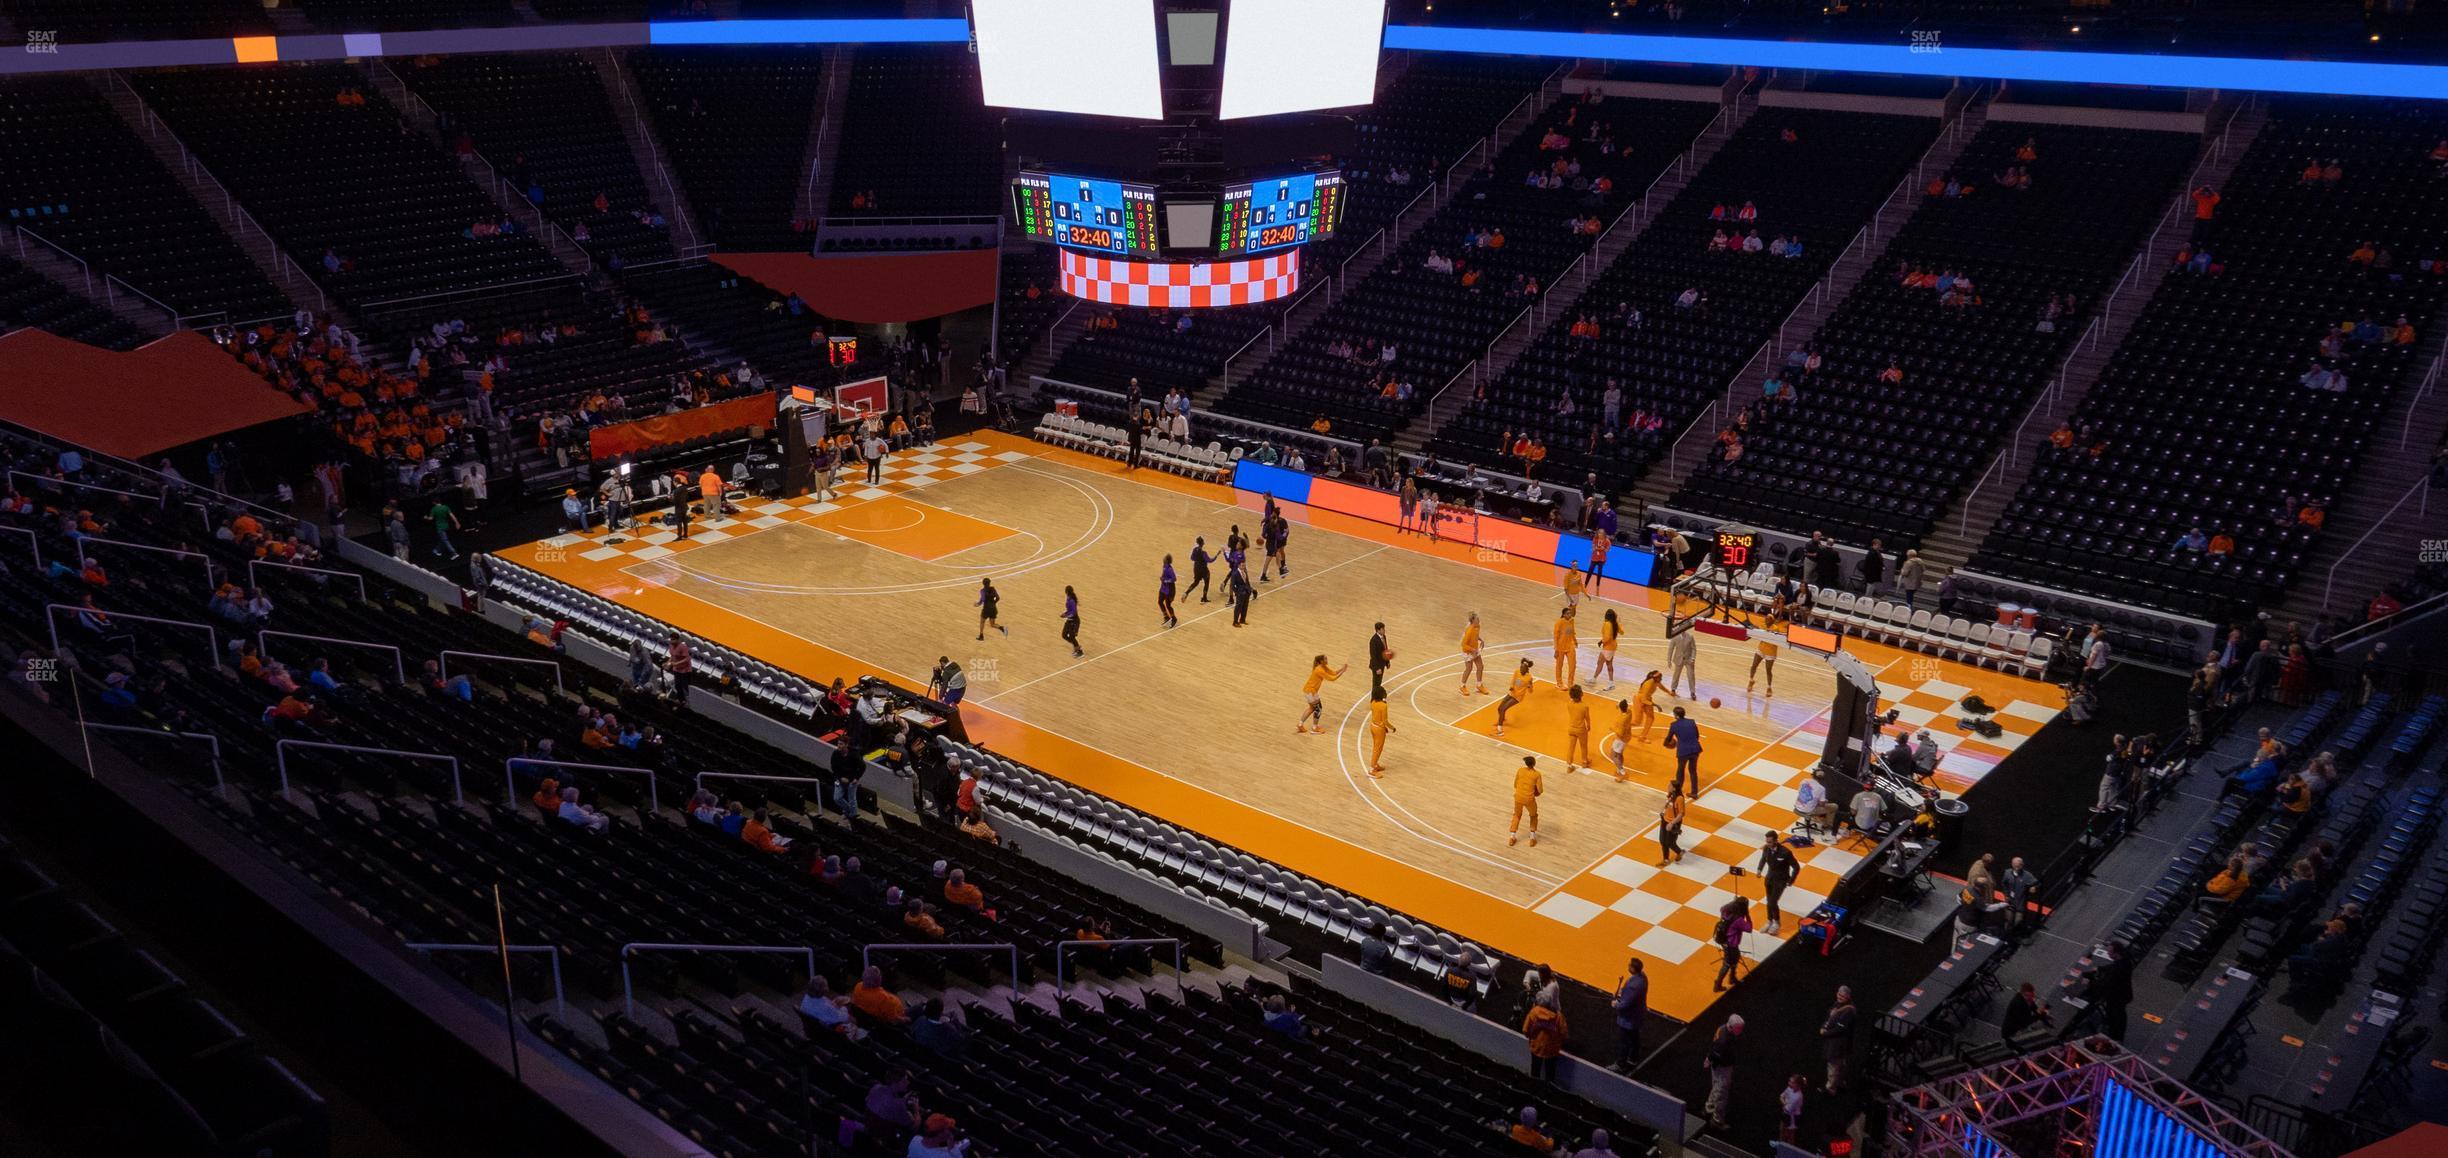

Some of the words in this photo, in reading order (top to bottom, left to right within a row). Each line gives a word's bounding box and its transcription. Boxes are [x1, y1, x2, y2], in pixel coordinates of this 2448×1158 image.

[1060, 205, 1066, 217] 0
[1300, 204, 1306, 215] 0
[1110, 212, 1117, 224] 0
[1256, 211, 1262, 223] 0
[1070, 227, 1110, 246] 32:40
[1261, 226, 1295, 245] 32:40
[1720, 535, 1751, 547] 32:40
[1724, 546, 1746, 565] 30
